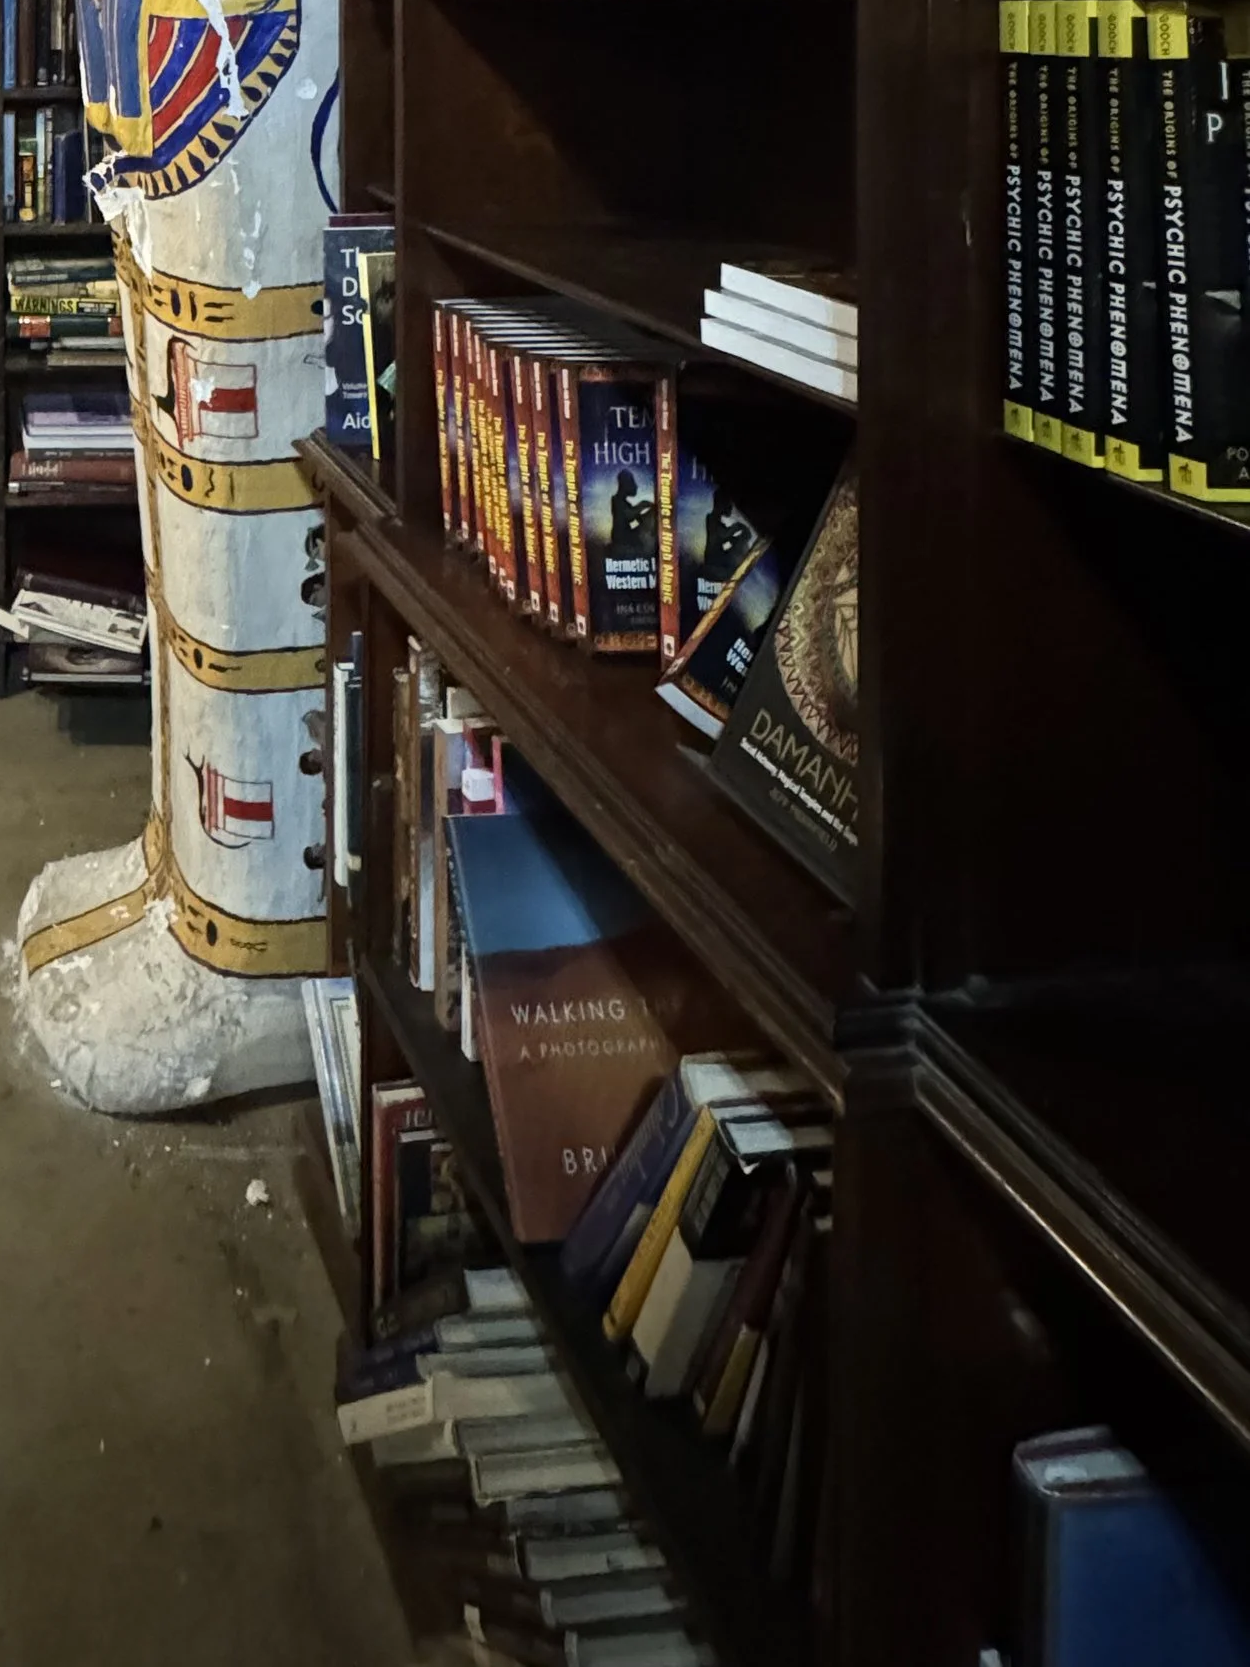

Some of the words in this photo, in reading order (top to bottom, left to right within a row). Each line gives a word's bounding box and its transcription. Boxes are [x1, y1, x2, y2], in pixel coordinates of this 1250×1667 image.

[1158, 14, 1172, 56] GOOCH
[1161, 70, 1175, 96] THE
[1162, 100, 1178, 157] ORIGINS
[1005, 164, 1022, 253] PSYCHIC
[1036, 170, 1054, 260] PSYCHIC
[1064, 174, 1083, 267] PSYCHIC
[1106, 179, 1125, 275] PSYCHIC
[1162, 185, 1188, 285] PSYCHIC
[14, 297, 75, 313] WARNINGS
[1006, 258, 1023, 390] PHENOMENA
[1037, 267, 1055, 402] PHENOMENA
[1066, 274, 1086, 414] PHENOMENA
[1107, 282, 1129, 425] PHENOMENA
[1168, 291, 1194, 443] PHENOMENA
[517, 424, 527, 440] The
[537, 432, 547, 448] The
[565, 440, 575, 457] The
[518, 442, 530, 482] Temple
[537, 450, 550, 490] Temple
[593, 441, 650, 466] HIGH
[660, 451, 671, 470] The
[565, 459, 578, 502] Temple
[660, 473, 672, 515] Temple
[521, 497, 534, 523] High
[541, 506, 554, 533] High
[568, 516, 582, 544] High
[542, 536, 556, 573] Magic
[605, 557, 650, 574] Hermetic
[661, 531, 674, 560] High
[570, 547, 584, 585] Magic
[606, 573, 647, 590] Western
[662, 563, 676, 604] Magic
[510, 998, 626, 1027] WALKING
